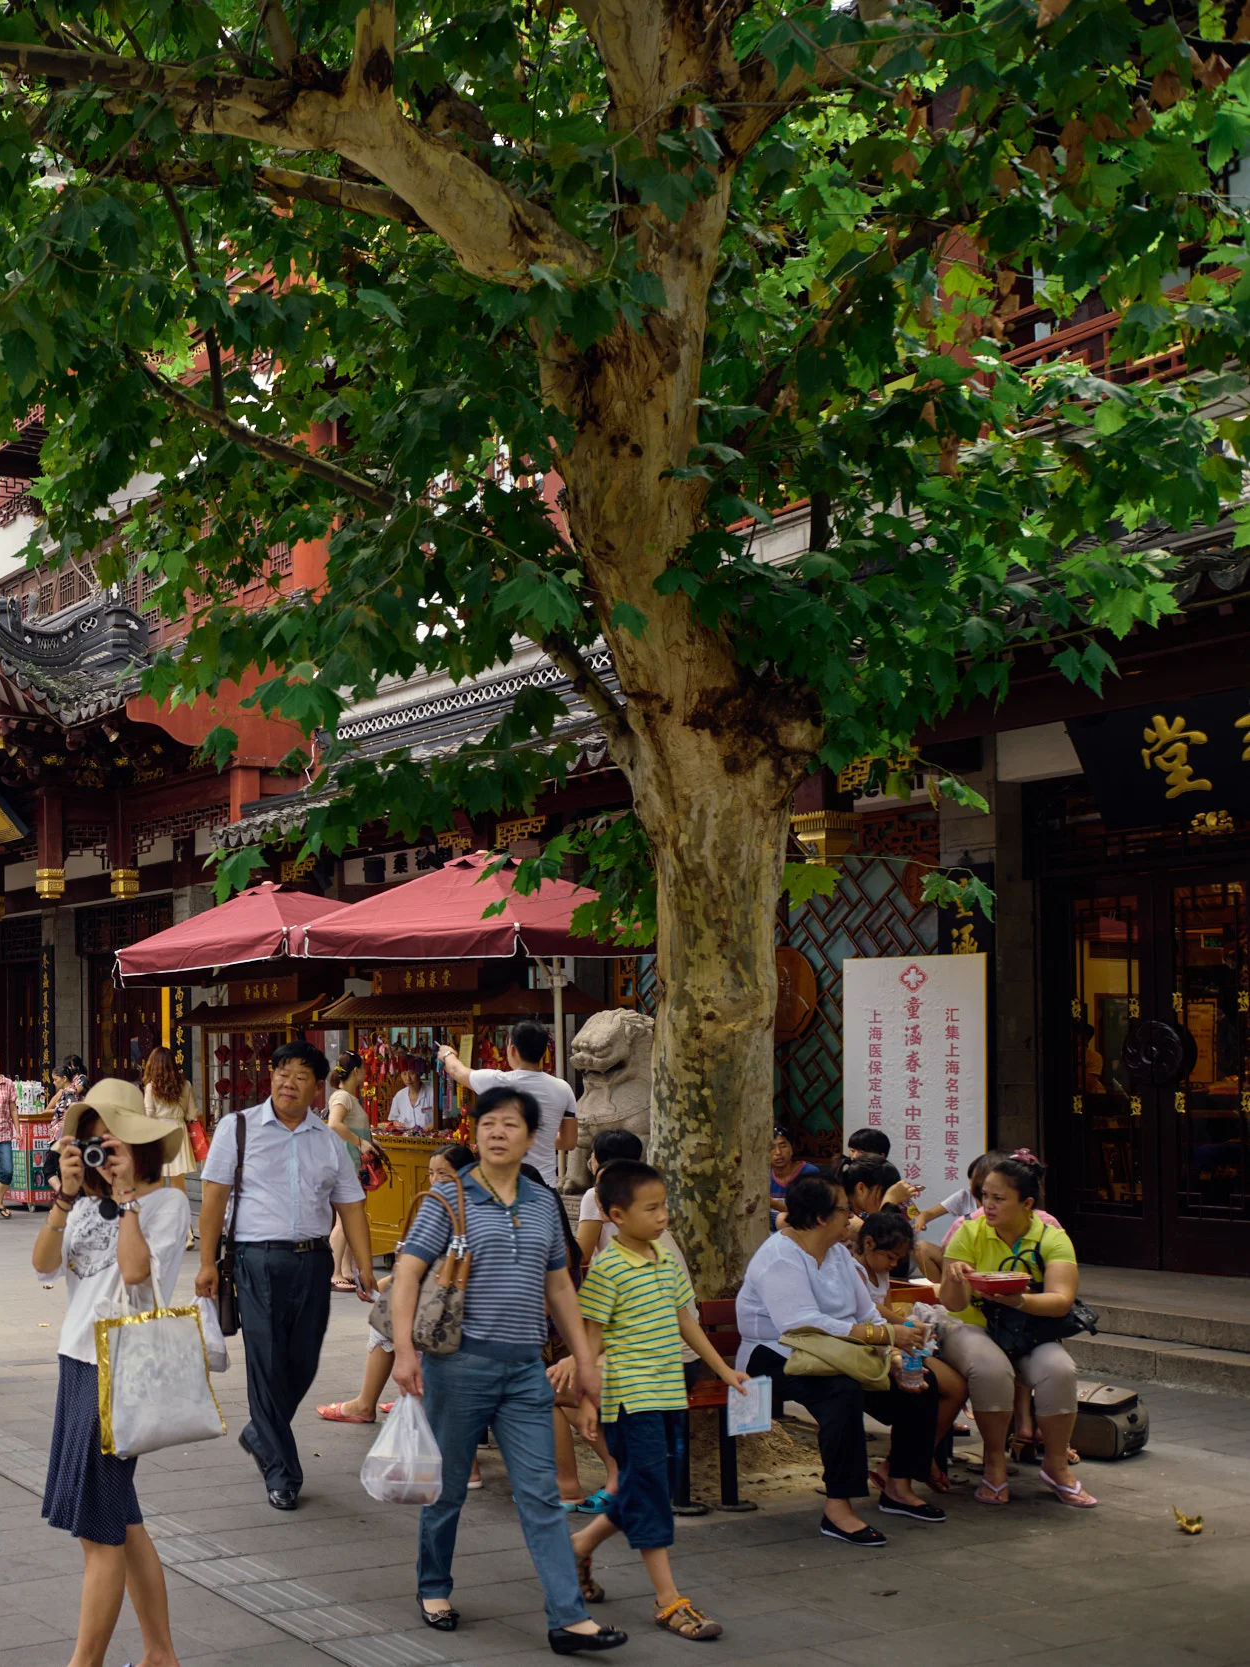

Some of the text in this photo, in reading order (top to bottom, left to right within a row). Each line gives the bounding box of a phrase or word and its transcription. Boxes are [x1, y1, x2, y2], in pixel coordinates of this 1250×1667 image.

[1141, 714, 1250, 799] 堂
[868, 1009, 883, 1126] 上海医保定点医
[945, 1008, 960, 1181] 汇集上海名老中医专家
